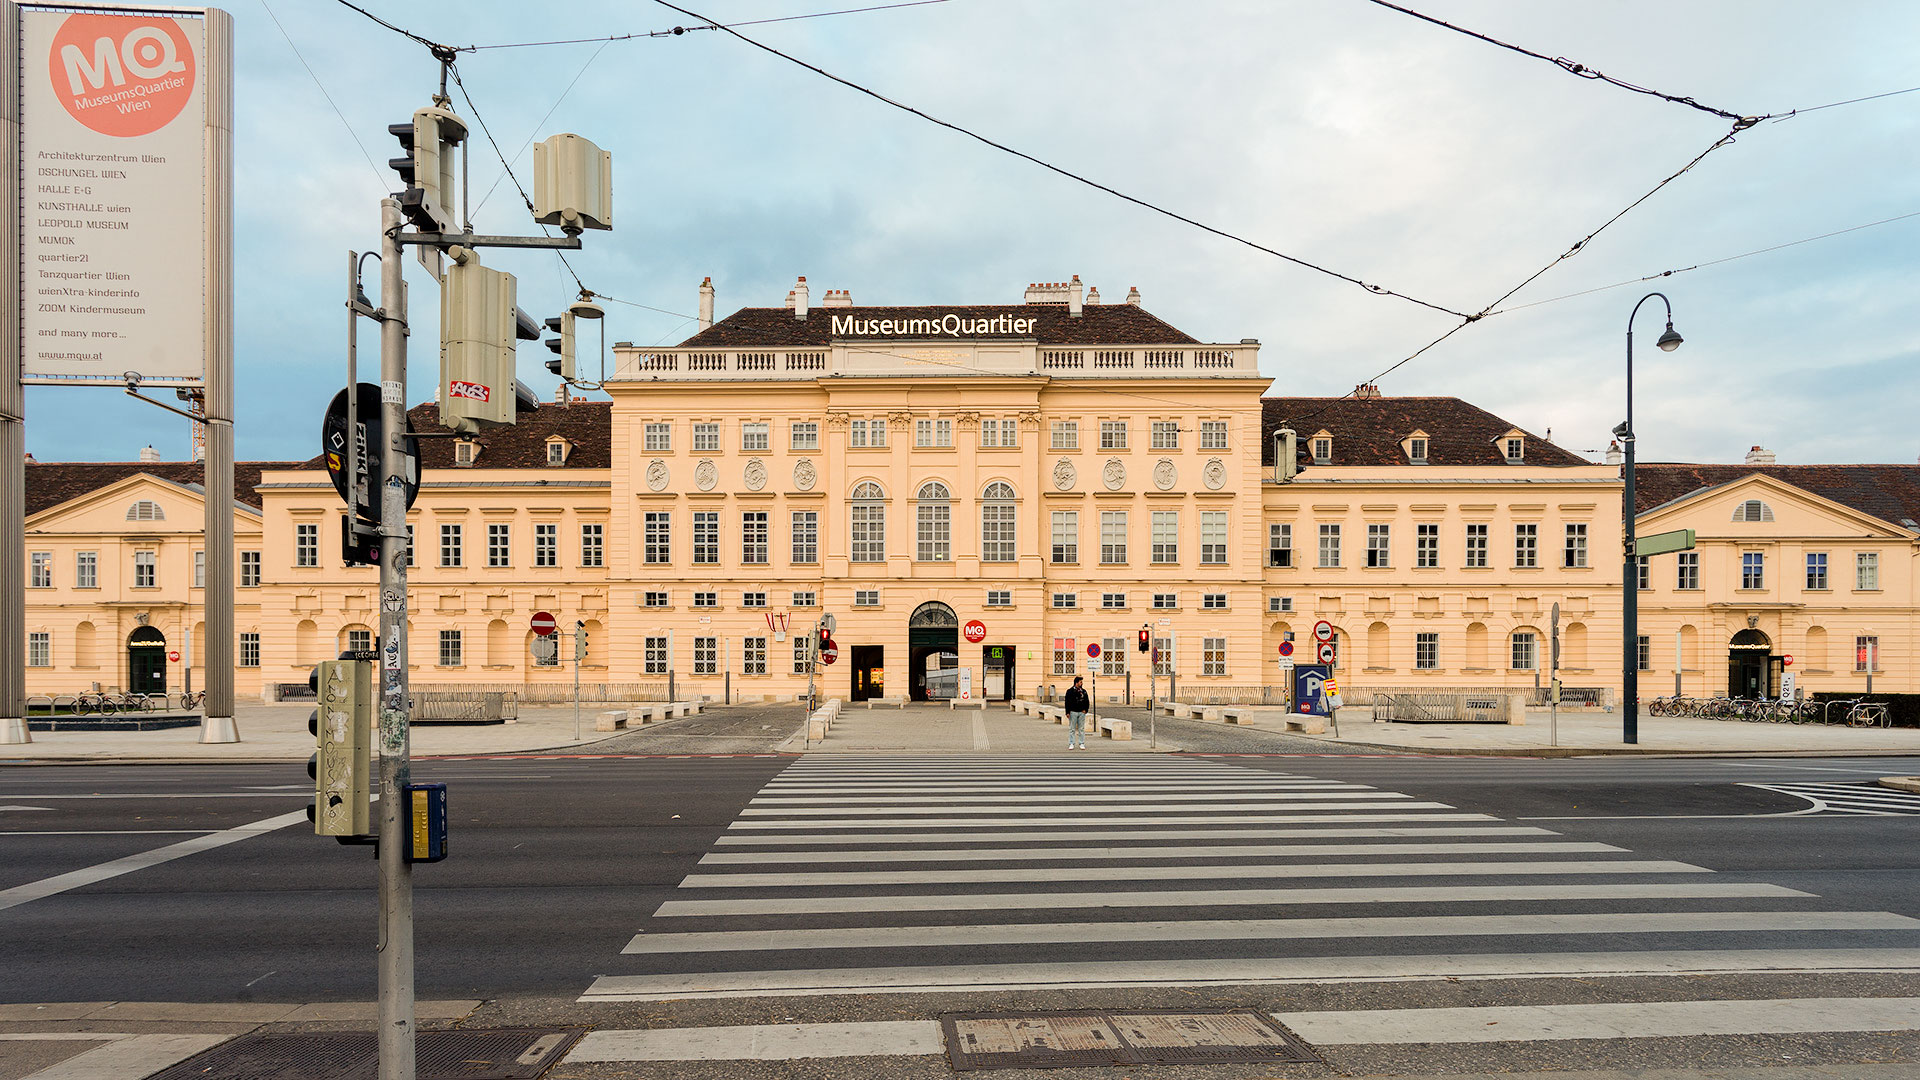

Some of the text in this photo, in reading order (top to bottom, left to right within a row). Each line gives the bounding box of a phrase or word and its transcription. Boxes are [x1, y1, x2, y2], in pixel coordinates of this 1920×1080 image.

[60, 26, 186, 96] MQ
[74, 77, 185, 110] MuseumsQuartier
[117, 100, 151, 115] Wien
[38, 151, 166, 163] Architekturzentrum Wien
[38, 167, 127, 179] DSCHUNGEL WIEN
[38, 184, 71, 194] HALLE
[38, 202, 131, 213] KUNSTHALLE wien
[38, 219, 129, 230] LEOPOLD MUSEUM
[38, 235, 75, 245] MUMOK
[38, 254, 89, 263] quartier21
[38, 270, 130, 280] Tanzquartier Wien
[38, 287, 140, 298] wienXtra-kinderinfo
[38, 304, 146, 315] ZOOM Kindermuseum
[831, 314, 1037, 337] MuseumsQuartier
[38, 329, 58, 337] and
[61, 331, 88, 339] many
[38, 352, 102, 361] www.mqw.at
[965, 626, 985, 635] MQ
